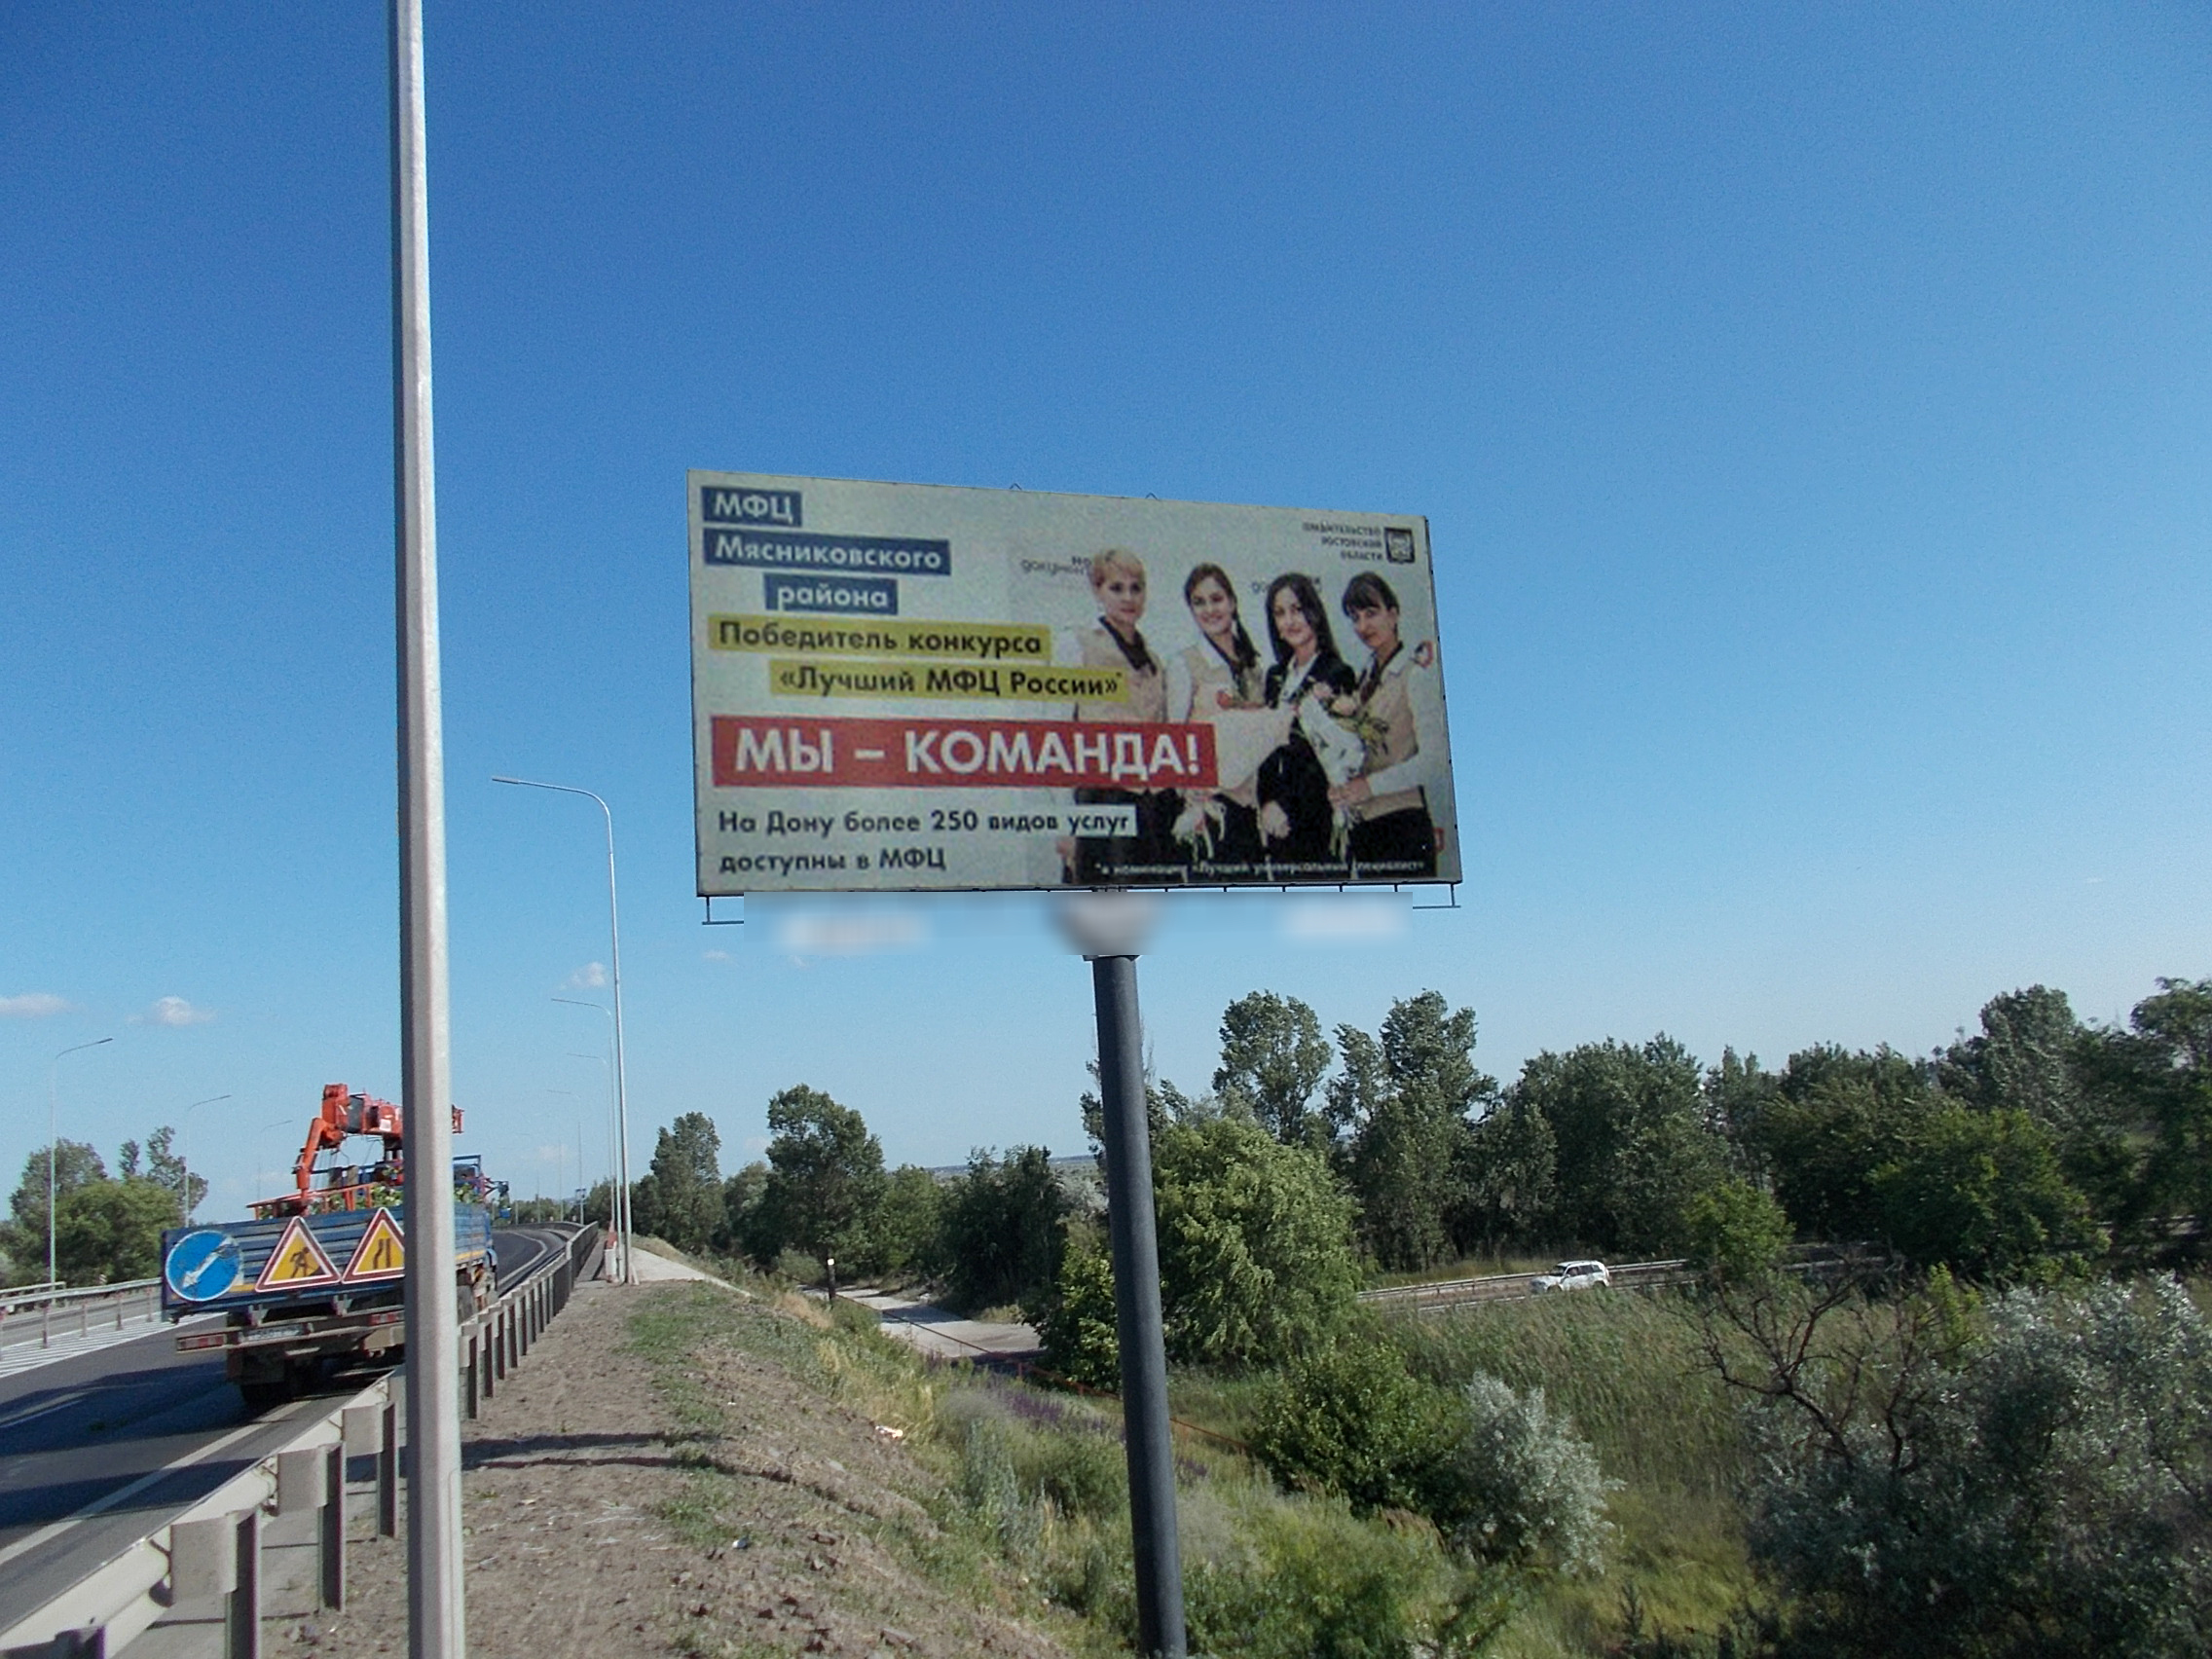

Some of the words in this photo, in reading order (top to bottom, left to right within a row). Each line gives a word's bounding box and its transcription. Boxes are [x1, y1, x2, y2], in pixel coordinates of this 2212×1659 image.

[714, 492, 793, 524] МФЦ
[715, 535, 941, 570] Мясниковского
[779, 582, 889, 613] района
[719, 620, 898, 650] Победитель
[908, 633, 1042, 659] конкурса
[780, 665, 915, 697] «Лучший
[926, 668, 1001, 697] МФЦ
[735, 727, 832, 773] МЫ
[905, 728, 1198, 781] КОМАНДА!
[719, 810, 756, 832] На
[766, 810, 834, 838] Дону
[843, 811, 921, 832] более
[930, 810, 979, 831] 250
[988, 815, 1058, 832] видов
[1068, 815, 1129, 836] услуг
[719, 854, 846, 876] доступны
[856, 855, 869, 869] в
[879, 847, 946, 871] МФЦ
